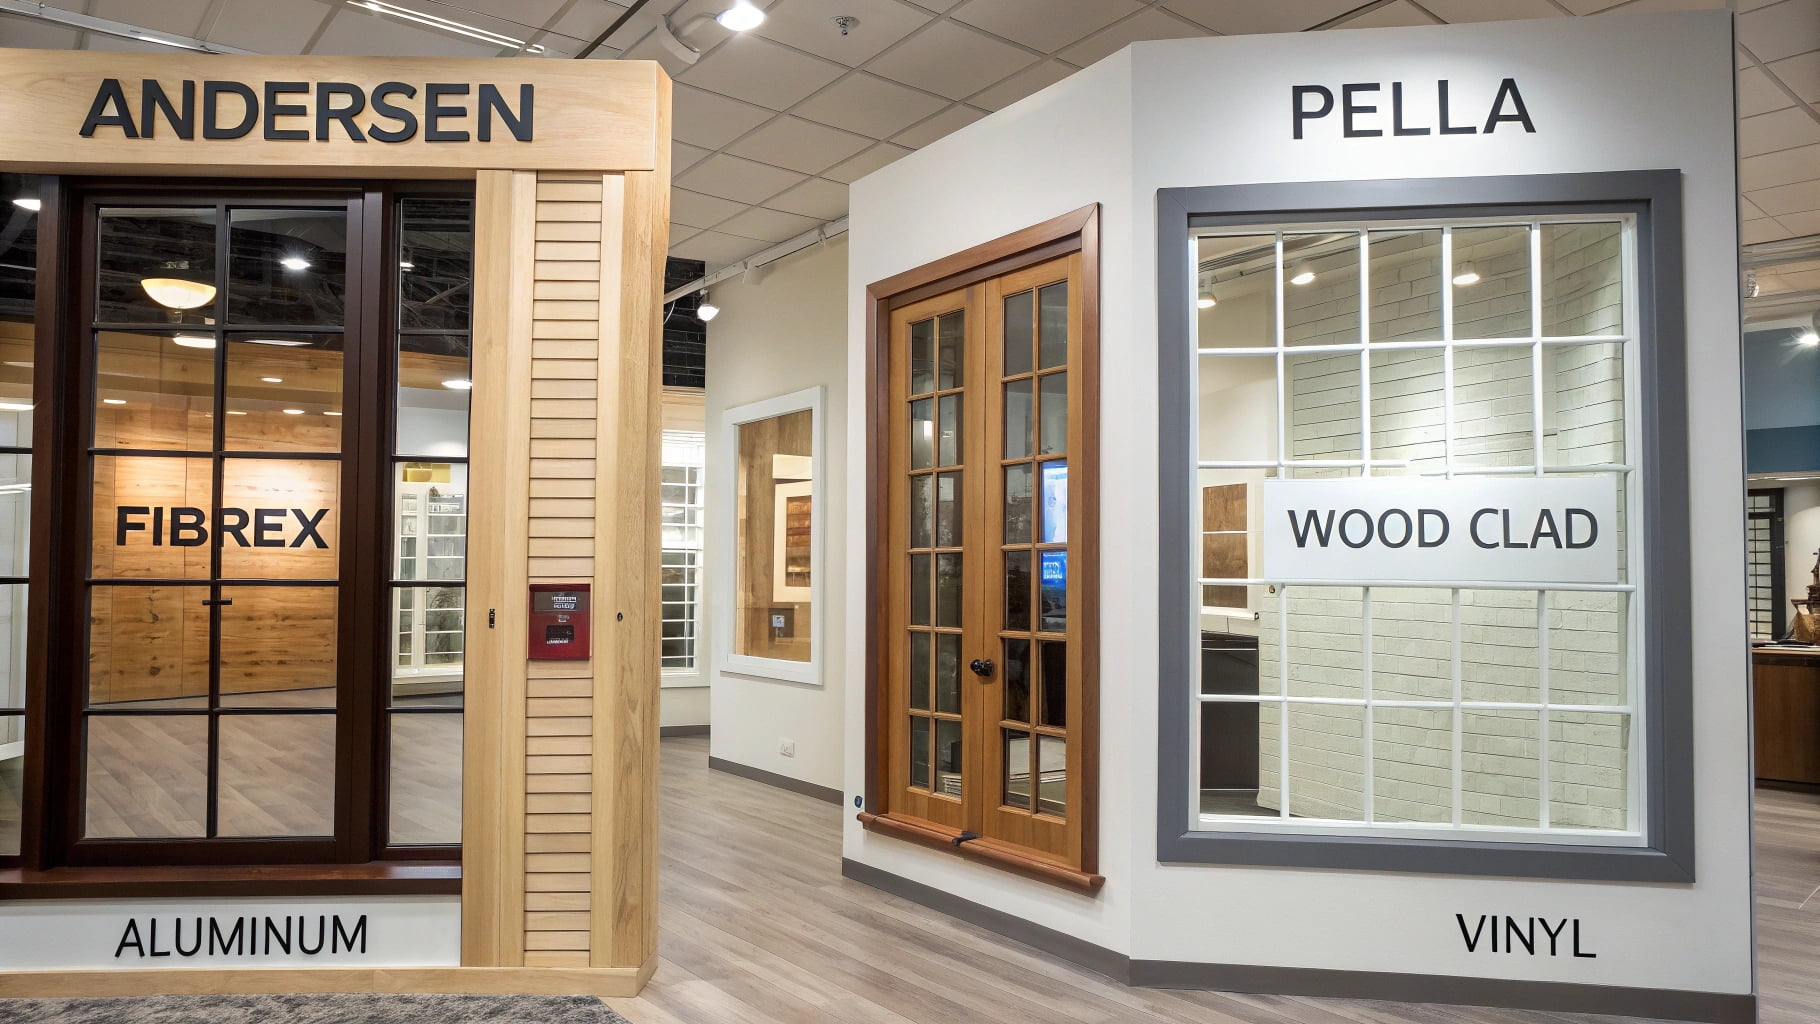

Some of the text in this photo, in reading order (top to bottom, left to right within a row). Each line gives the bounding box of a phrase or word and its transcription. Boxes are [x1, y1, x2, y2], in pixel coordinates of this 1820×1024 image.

[79, 77, 535, 143] ANDERSEN
[1292, 77, 1537, 140] PELLA
[116, 506, 330, 549] FIBREX
[1287, 508, 1599, 550] WOOD CLAD
[114, 915, 368, 959] ALUMINUM
[1455, 913, 1597, 959] VINYL
